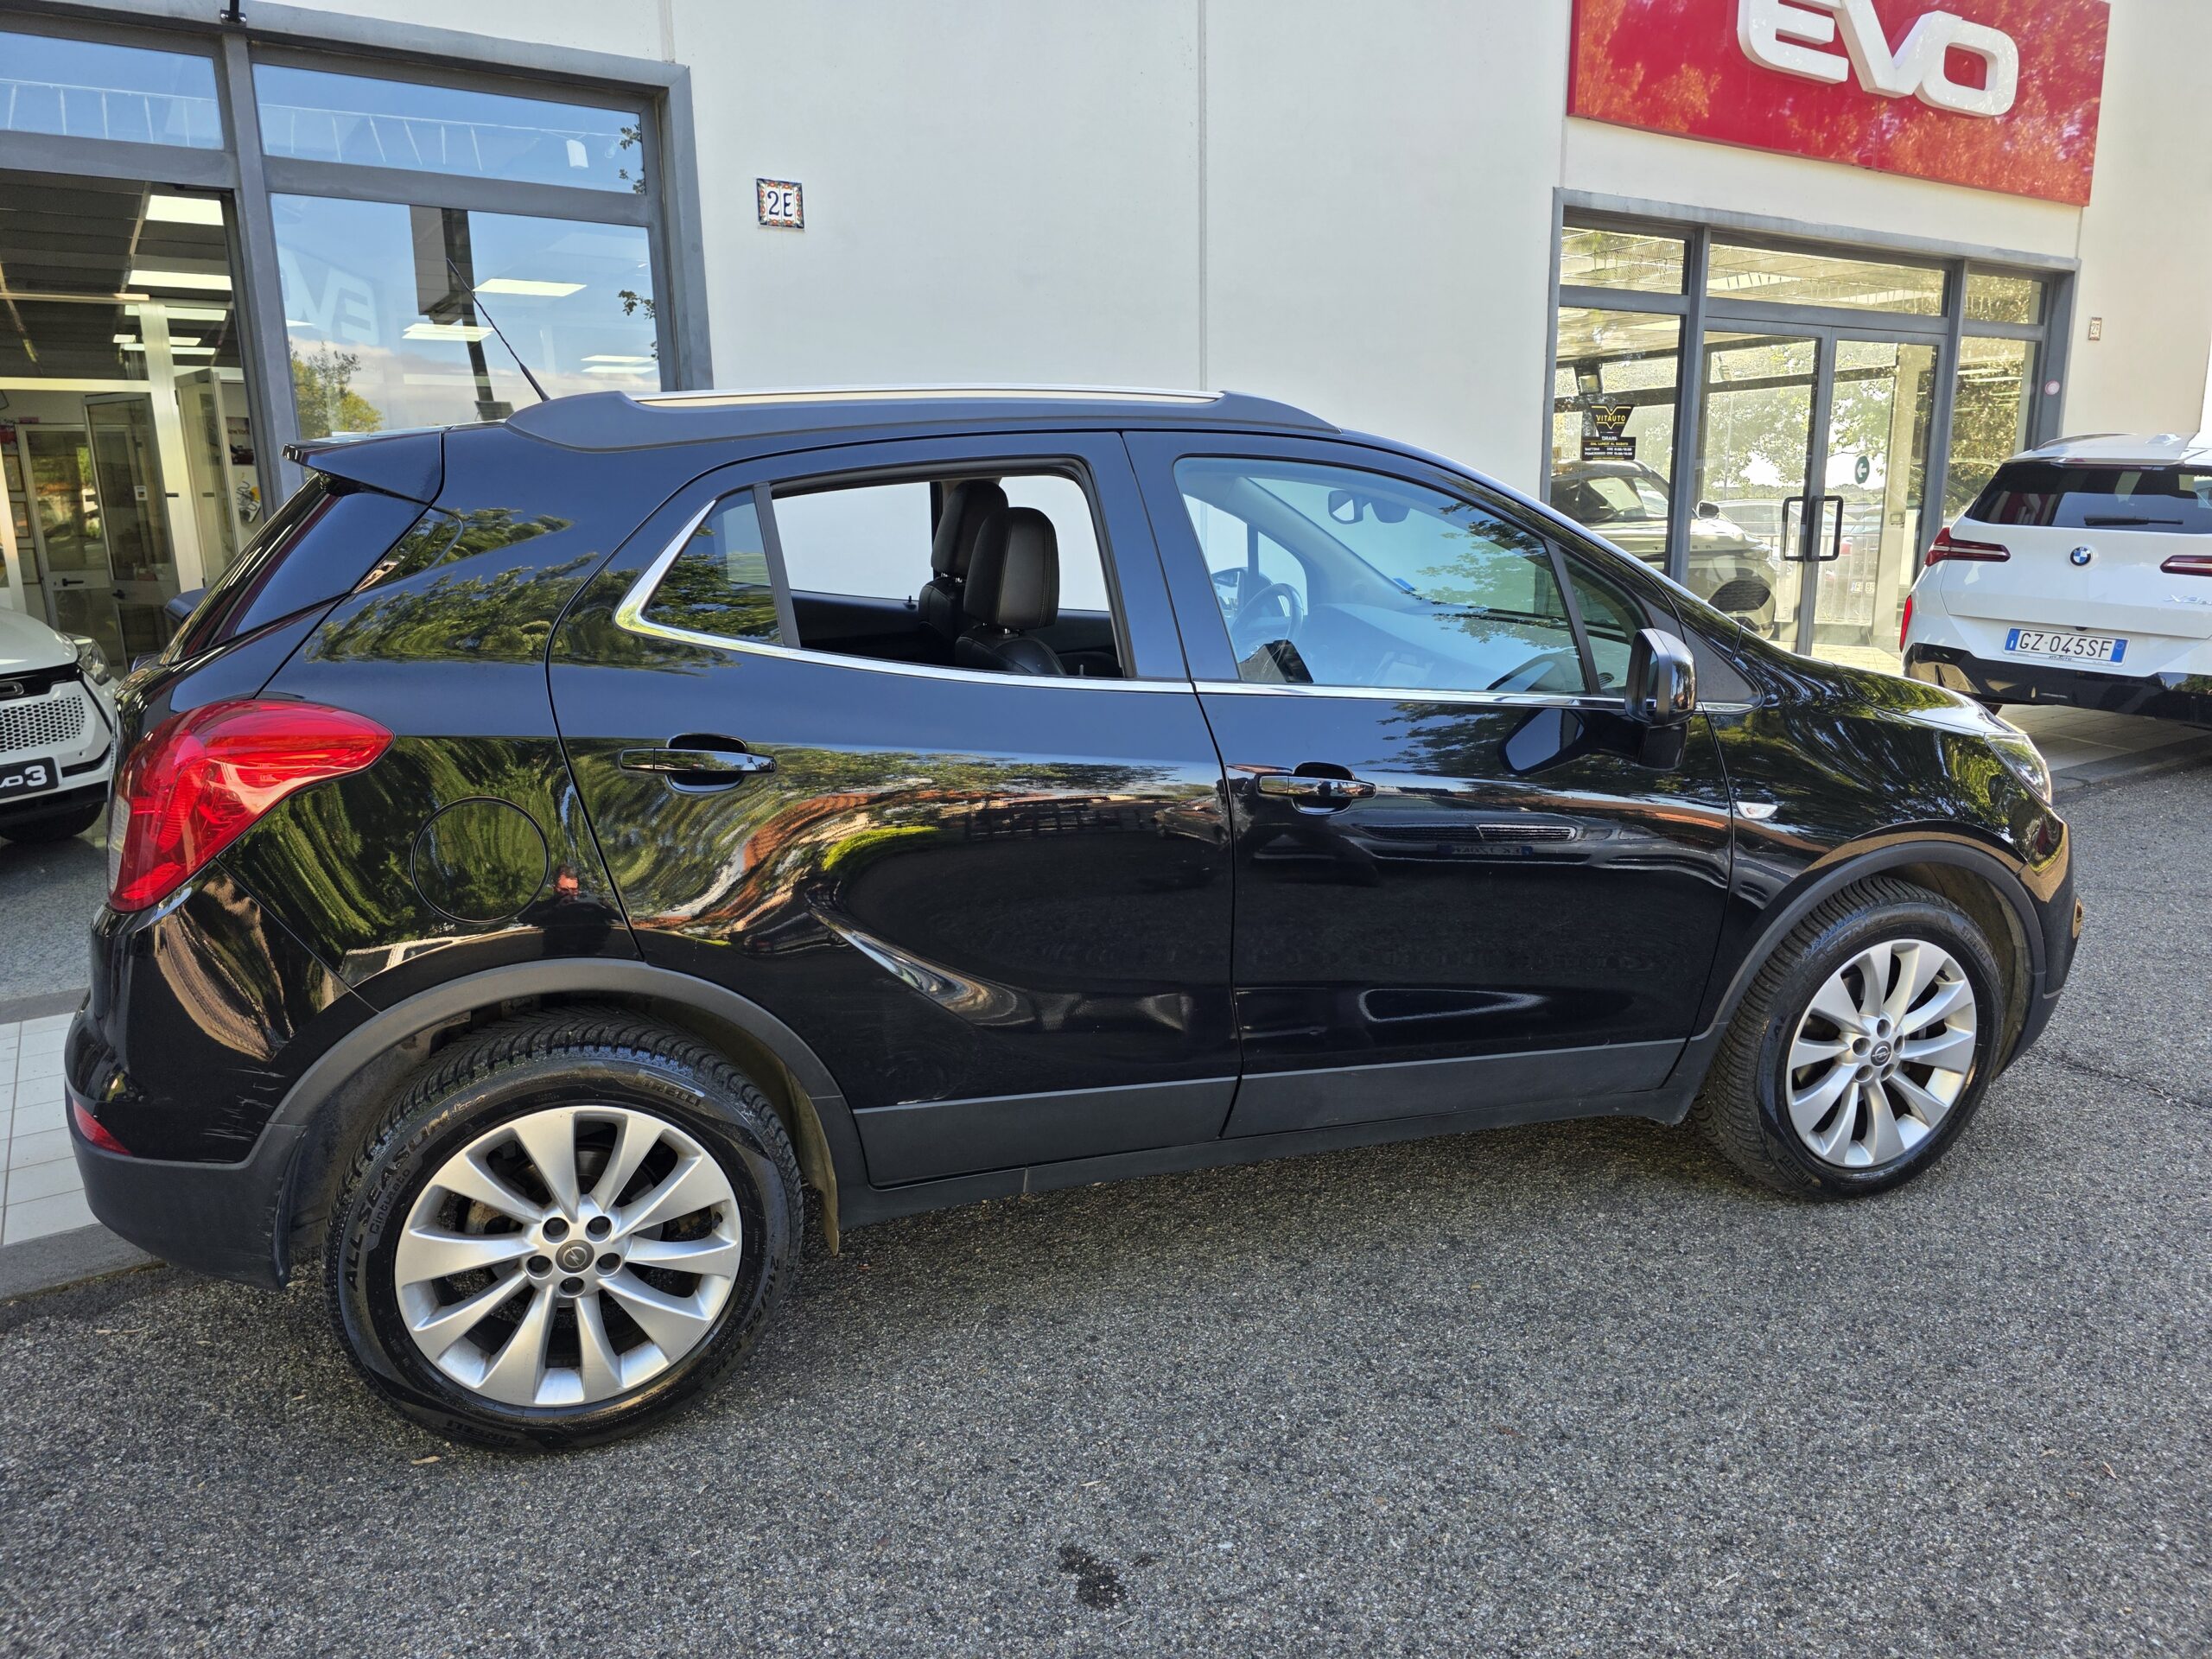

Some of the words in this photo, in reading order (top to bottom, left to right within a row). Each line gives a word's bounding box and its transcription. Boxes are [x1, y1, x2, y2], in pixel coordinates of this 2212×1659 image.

[1737, 0, 2018, 118] EVO
[767, 190, 793, 217] 2E
[2018, 632, 2044, 652] GZ
[2049, 635, 2113, 658] 045SF
[346, 1233, 364, 1293] ALL
